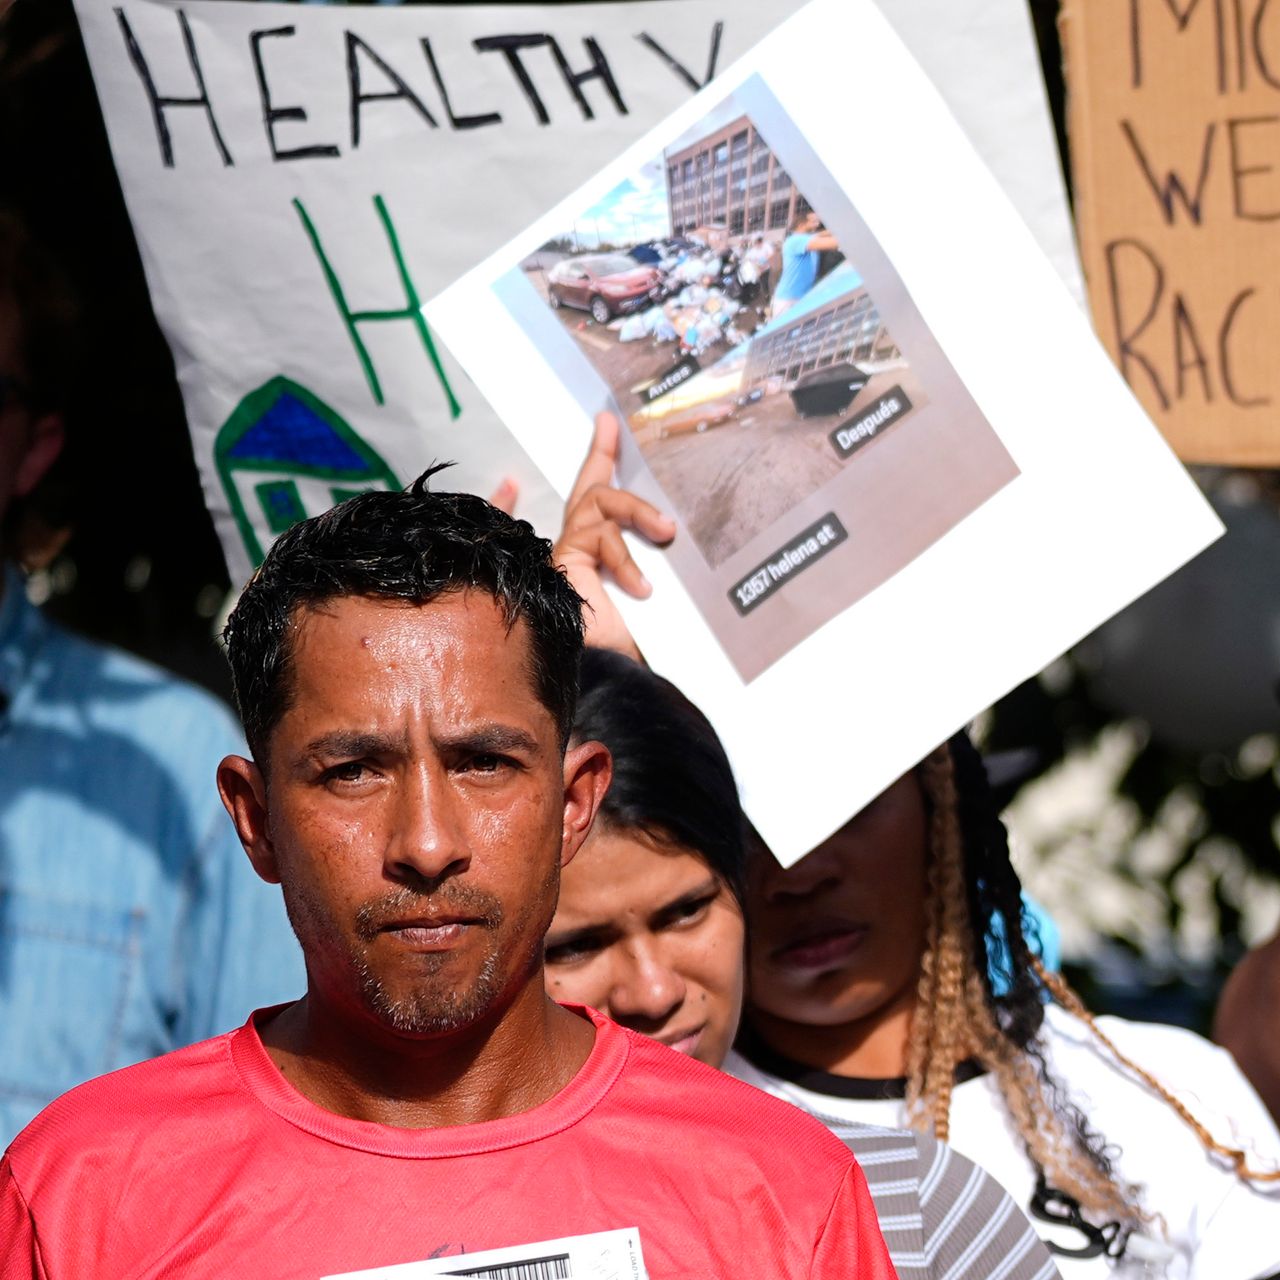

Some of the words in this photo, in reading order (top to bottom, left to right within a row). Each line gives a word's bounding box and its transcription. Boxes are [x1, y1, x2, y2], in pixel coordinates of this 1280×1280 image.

[836, 398, 902, 452] Después
[736, 571, 772, 608] 1357
[766, 540, 820, 582] helena
[816, 524, 836, 546] st
